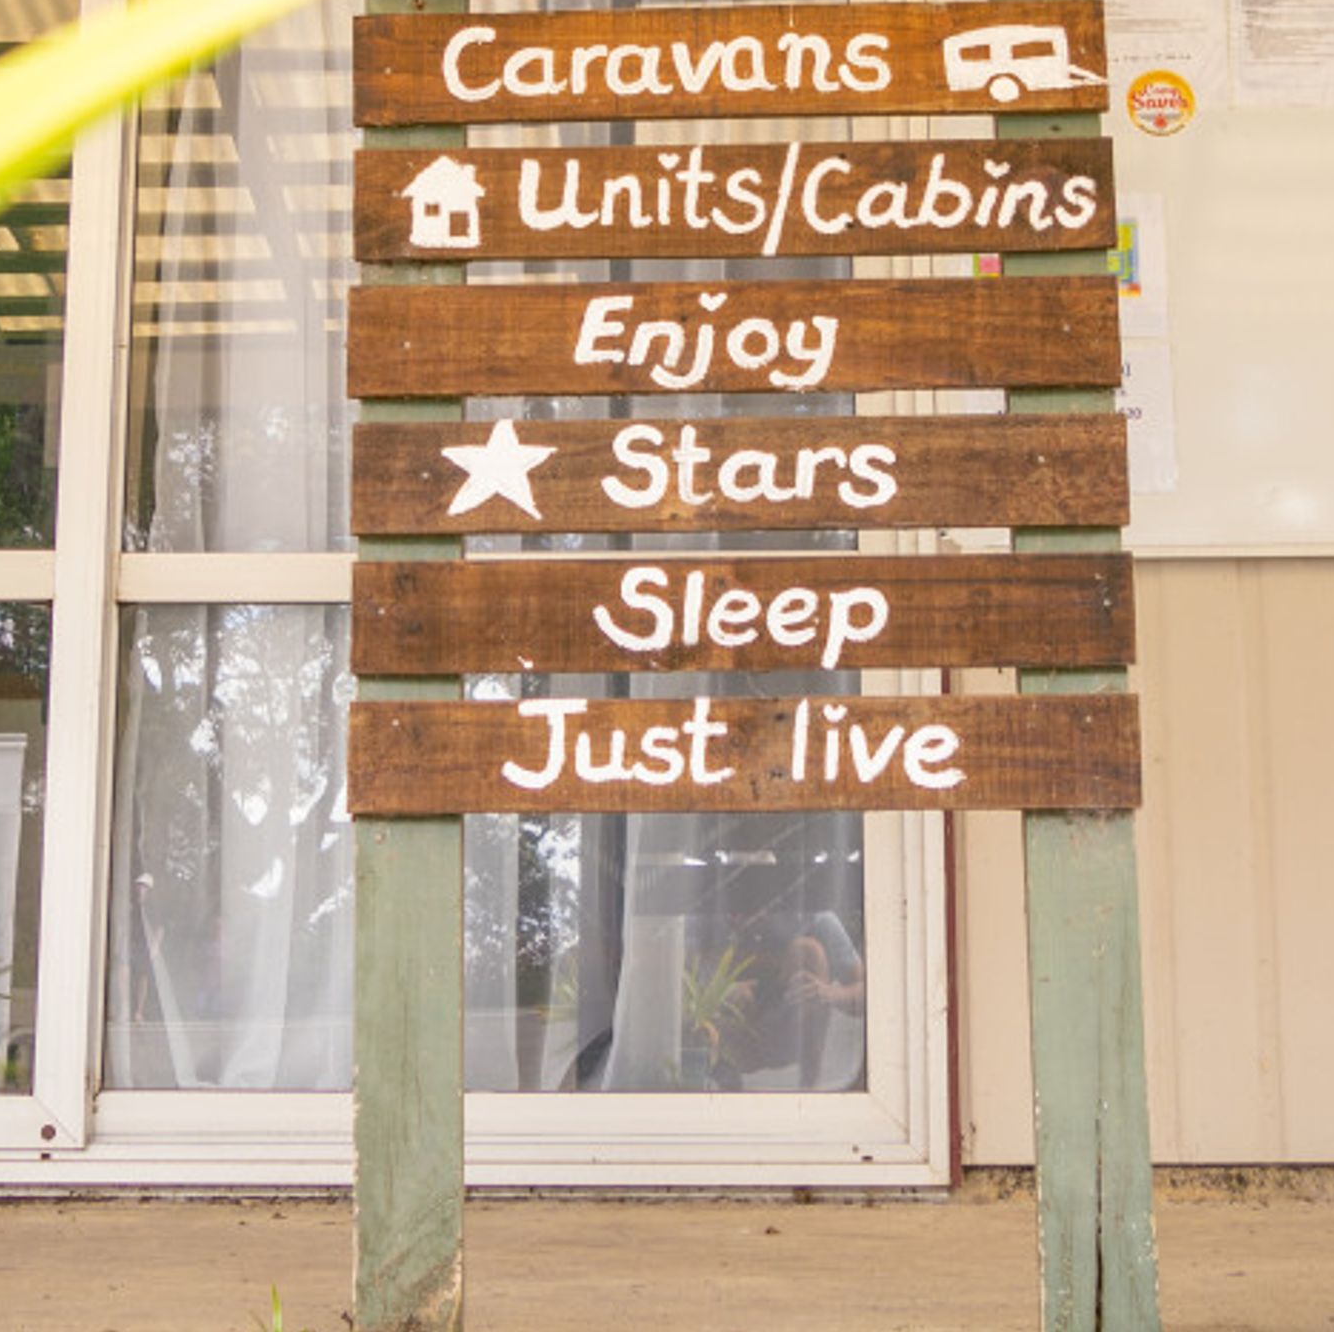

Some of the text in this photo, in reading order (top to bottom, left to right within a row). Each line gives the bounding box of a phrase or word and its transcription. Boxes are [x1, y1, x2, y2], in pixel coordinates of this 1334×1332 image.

[442, 25, 892, 103] Caravans
[517, 141, 1098, 257] Units/Cabins
[573, 293, 839, 391] Enjoy
[600, 423, 899, 510] Stars
[592, 566, 890, 670] Sleep
[500, 698, 967, 791] Just live
